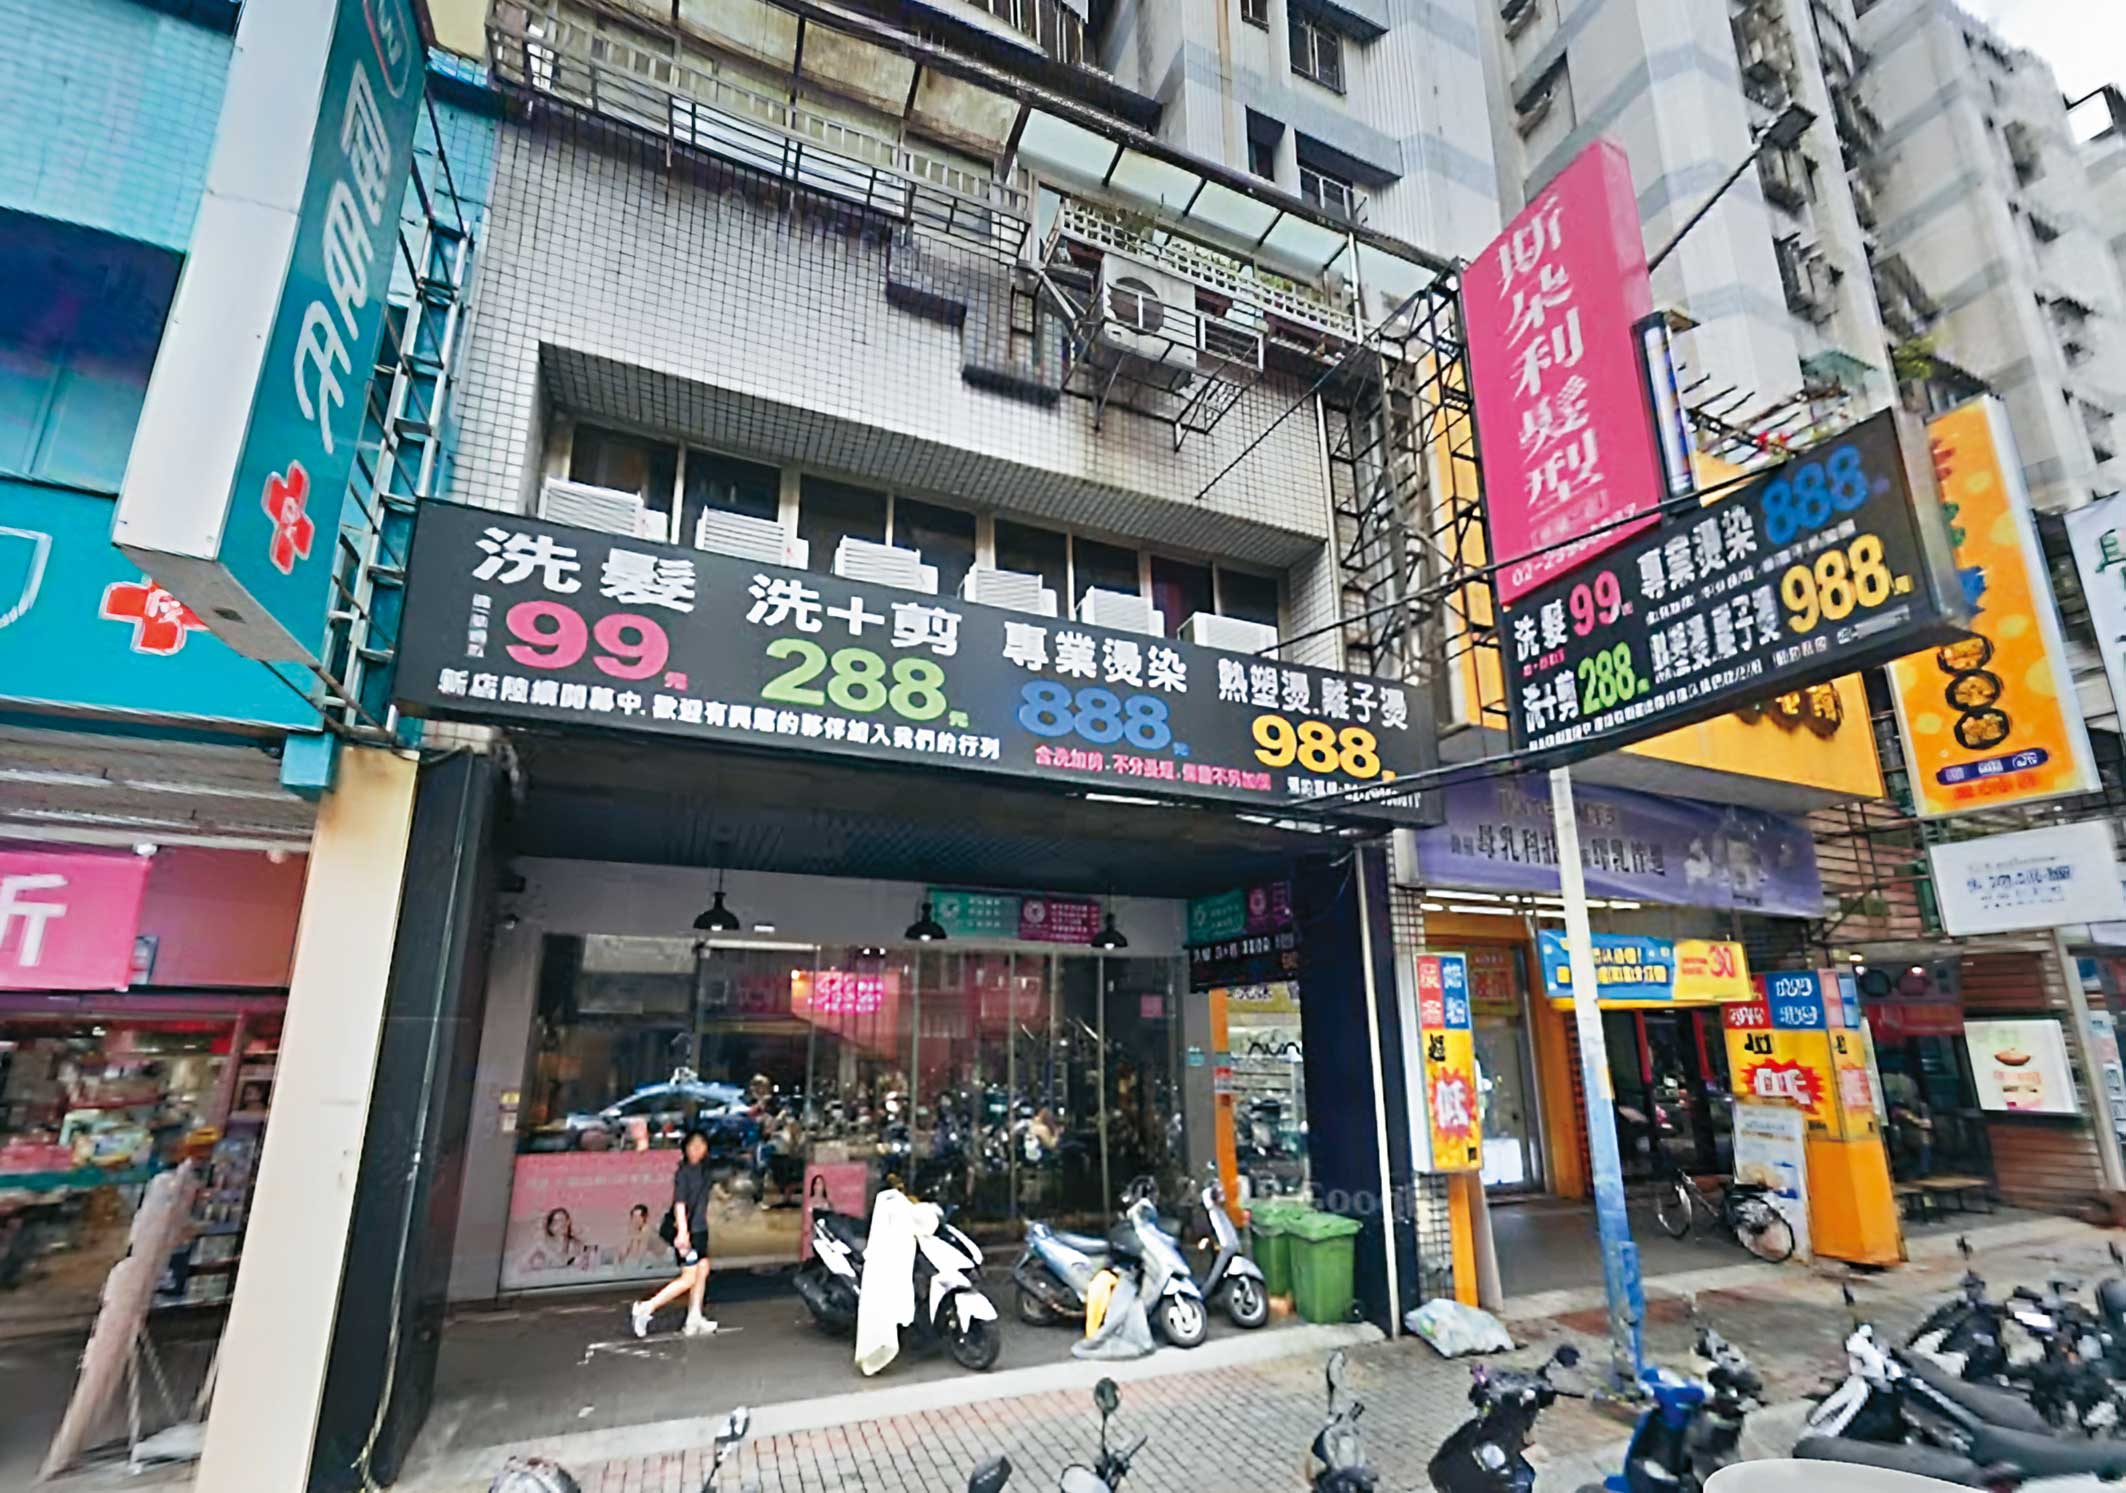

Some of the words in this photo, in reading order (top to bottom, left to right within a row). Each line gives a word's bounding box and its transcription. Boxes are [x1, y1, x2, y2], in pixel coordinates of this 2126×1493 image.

[1496, 194, 1604, 518] 斯朵利髮型
[472, 527, 696, 613] 洗髮
[1002, 621, 1187, 693] 專業燙染
[1514, 599, 1568, 662] 洗髮
